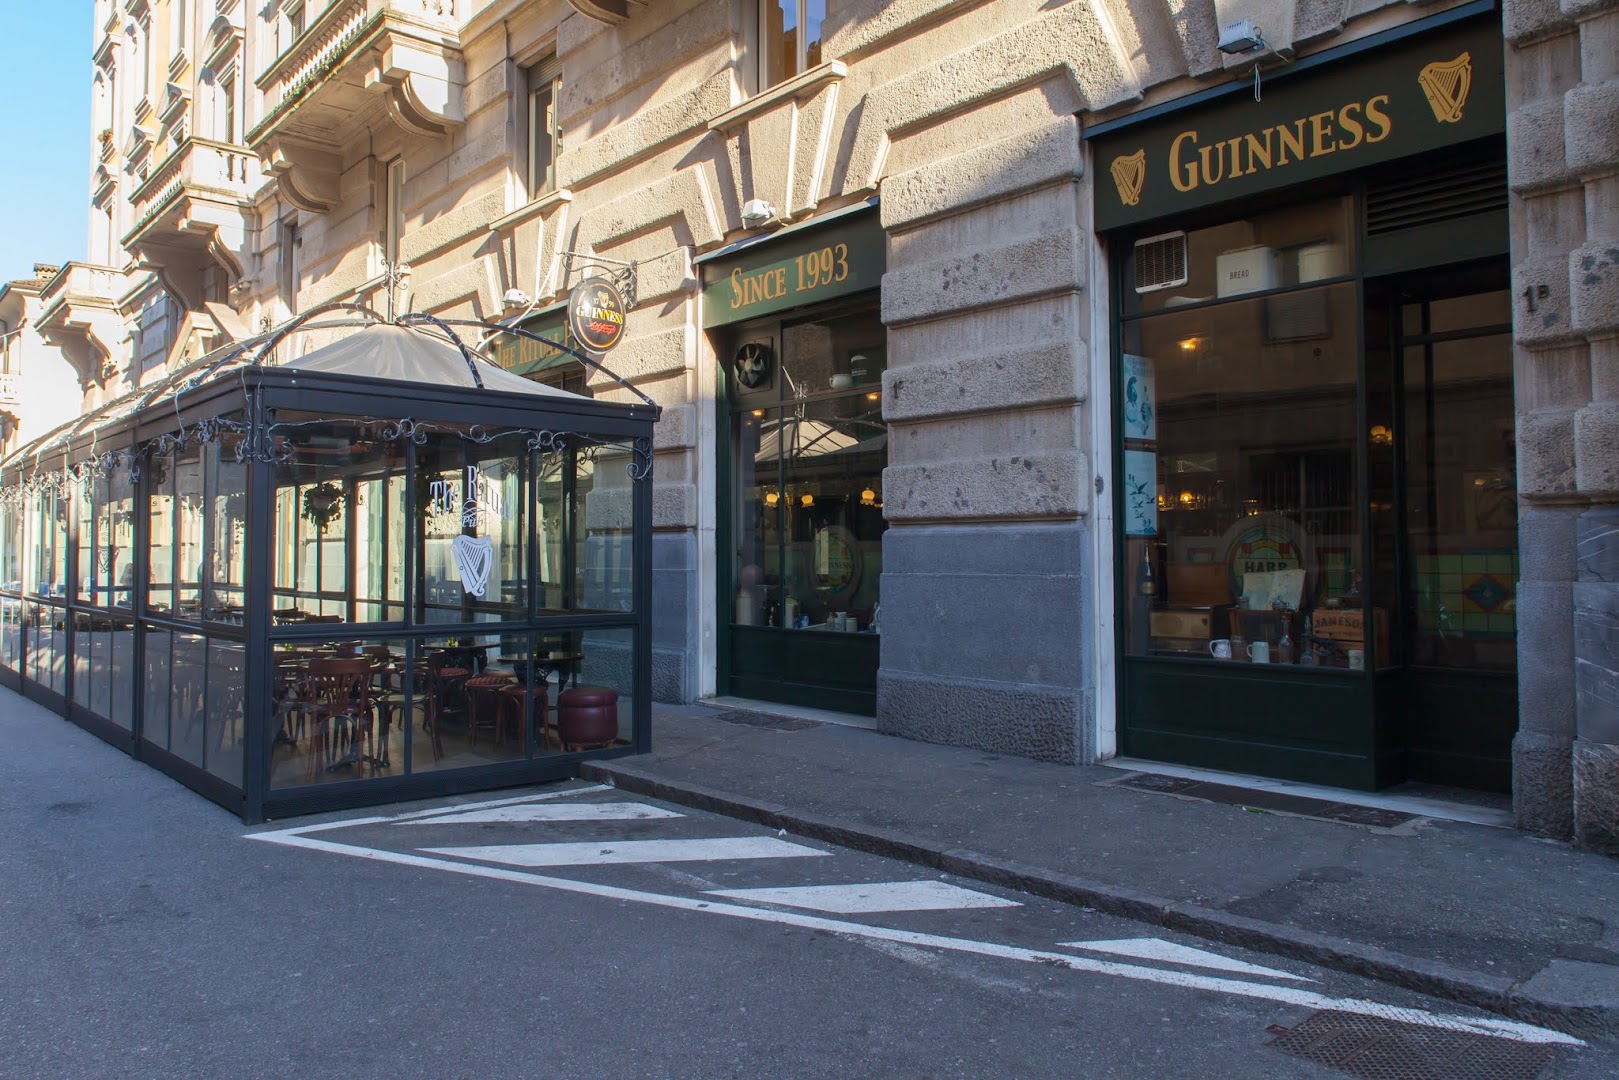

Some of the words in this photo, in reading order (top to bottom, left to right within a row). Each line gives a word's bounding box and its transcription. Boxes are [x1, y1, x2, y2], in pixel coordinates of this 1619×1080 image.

[1168, 94, 1392, 193] GUINNESS
[730, 267, 787, 309] SINCE
[795, 243, 849, 292] 1993
[1229, 269, 1250, 280] BREAD
[576, 305, 624, 325] GUINNESS
[496, 341, 516, 368] THE
[429, 479, 461, 519] The
[1244, 561, 1288, 573] HARP
[1315, 616, 1363, 629] JAMESO
